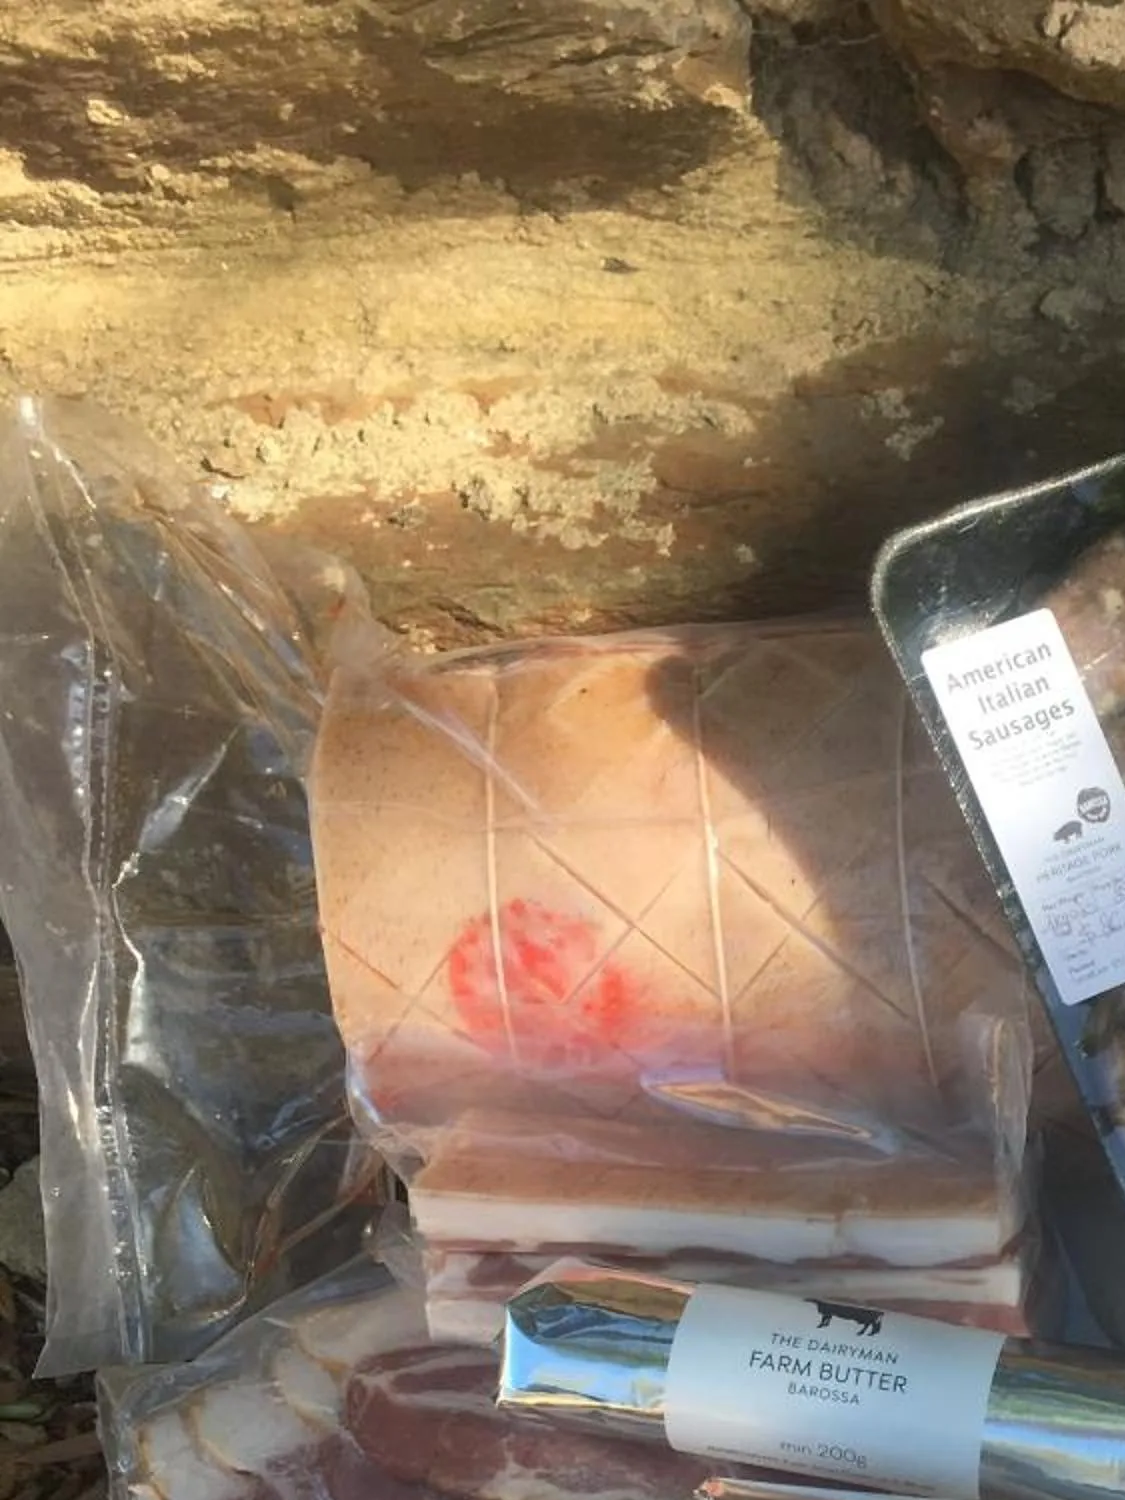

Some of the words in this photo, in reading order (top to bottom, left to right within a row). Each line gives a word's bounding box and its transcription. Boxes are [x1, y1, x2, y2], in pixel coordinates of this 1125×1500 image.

[945, 640, 1053, 694] American
[977, 672, 1050, 716] Italian
[968, 697, 1076, 751] Sausages
[771, 1332, 802, 1350] THE
[807, 1337, 899, 1365] DAIRYMAN
[749, 1351, 813, 1379] FARM
[819, 1362, 908, 1394] BUTTER
[787, 1382, 861, 1405] BAROSSA
